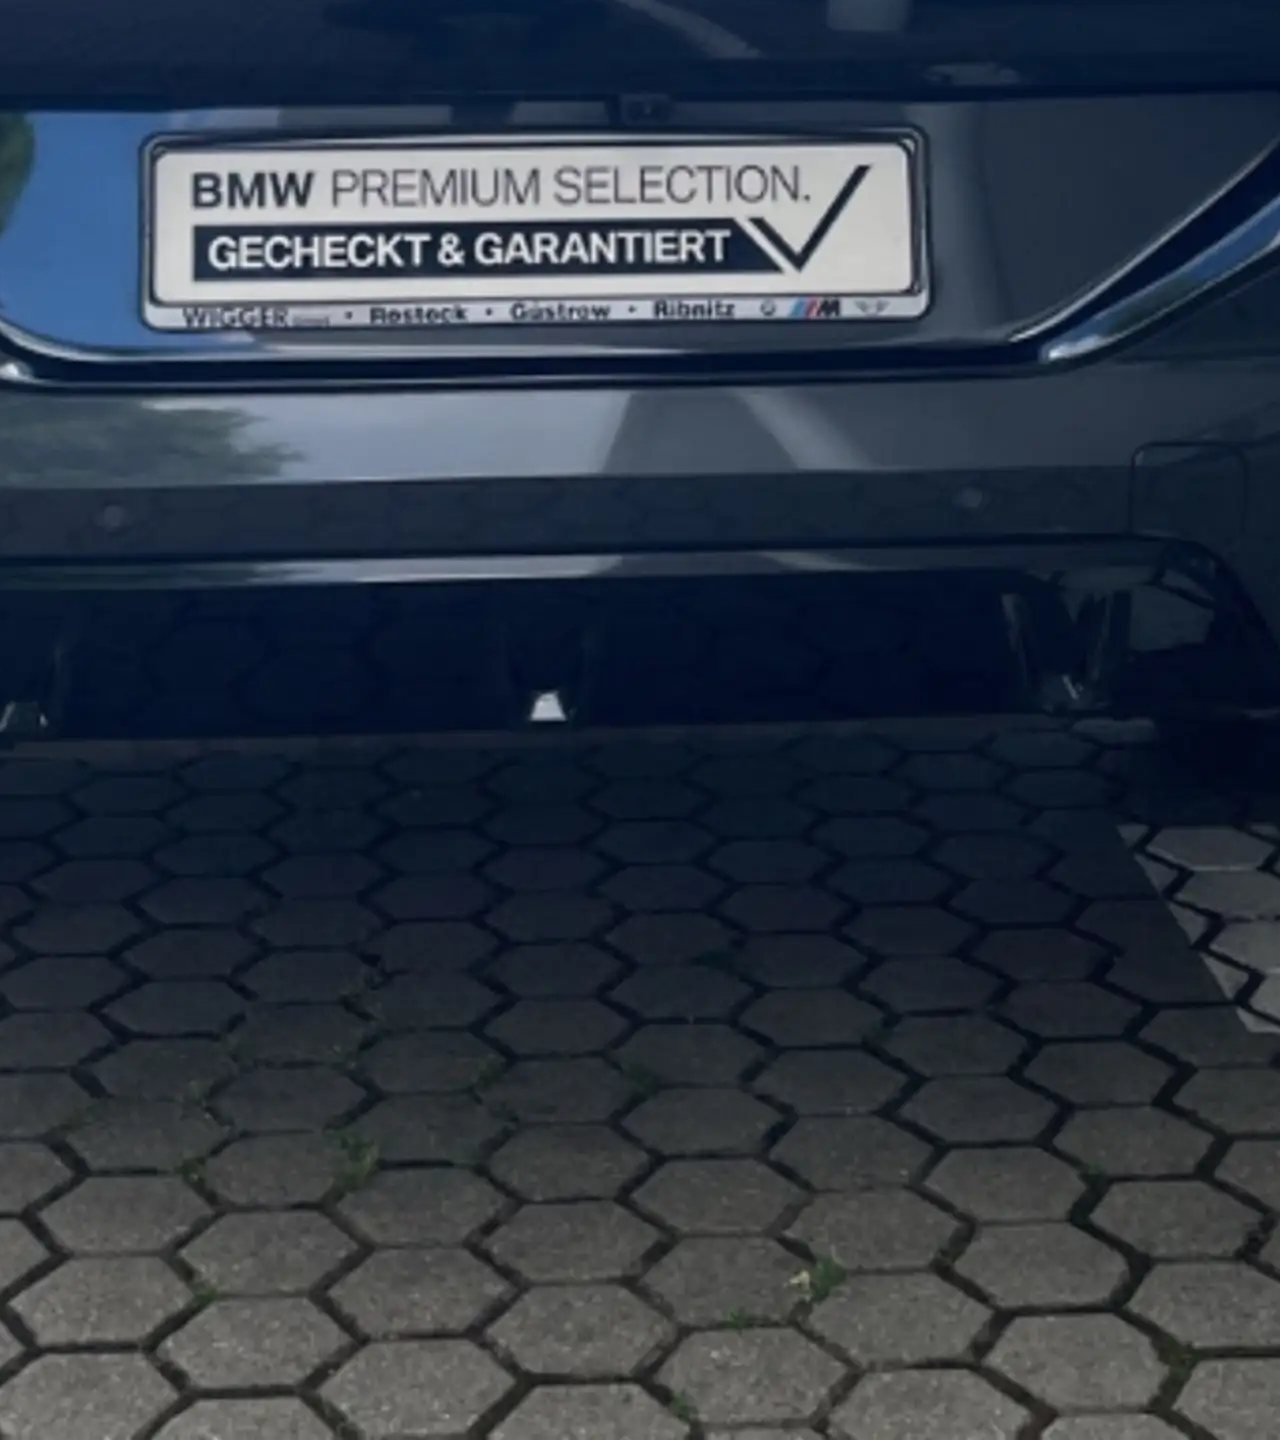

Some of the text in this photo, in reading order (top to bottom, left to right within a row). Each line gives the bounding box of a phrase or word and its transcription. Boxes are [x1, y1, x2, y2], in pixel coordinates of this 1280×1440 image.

[192, 164, 812, 210] BMW PREMIUM SELECTION.
[207, 228, 732, 270] GECHECKT & GARANTIERT
[181, 306, 290, 329] WIGGER
[653, 299, 736, 319] Ribnitz
